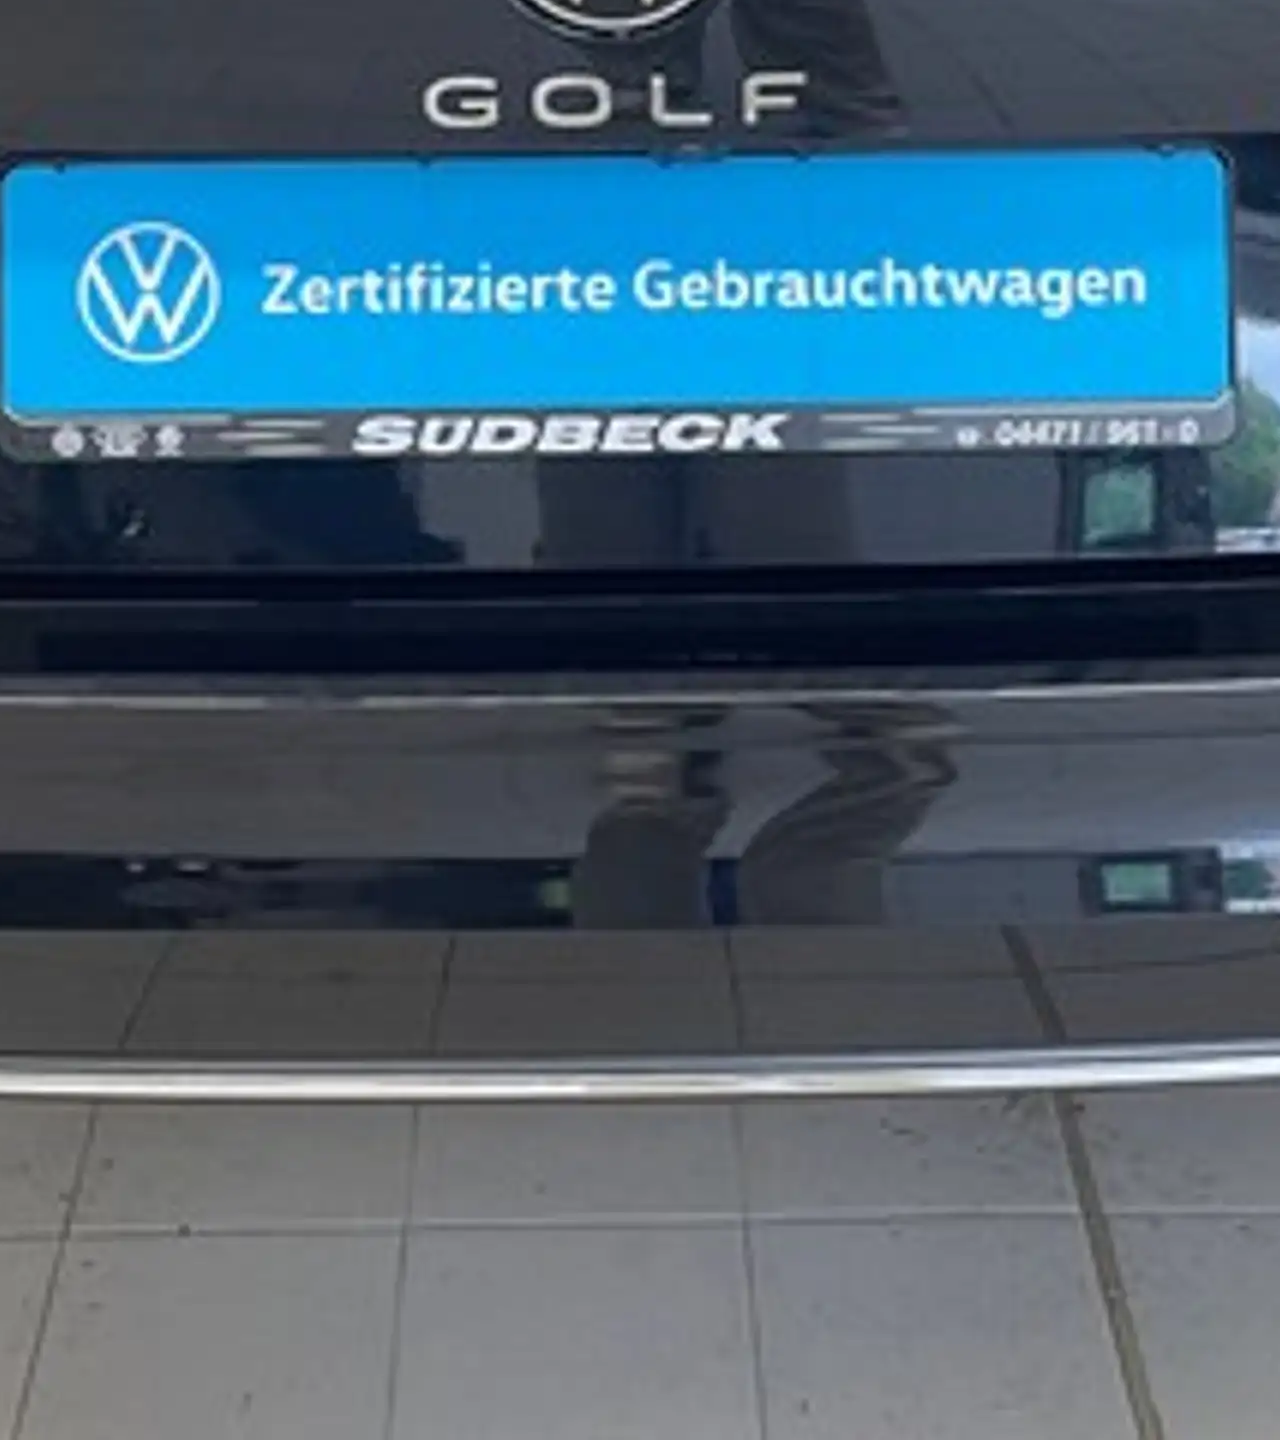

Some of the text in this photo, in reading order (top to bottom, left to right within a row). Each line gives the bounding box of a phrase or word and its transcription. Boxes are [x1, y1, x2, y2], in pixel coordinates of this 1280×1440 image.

[422, 71, 808, 129] GOLF
[261, 258, 1147, 317] Zertifizierte Gebrauchtwagen
